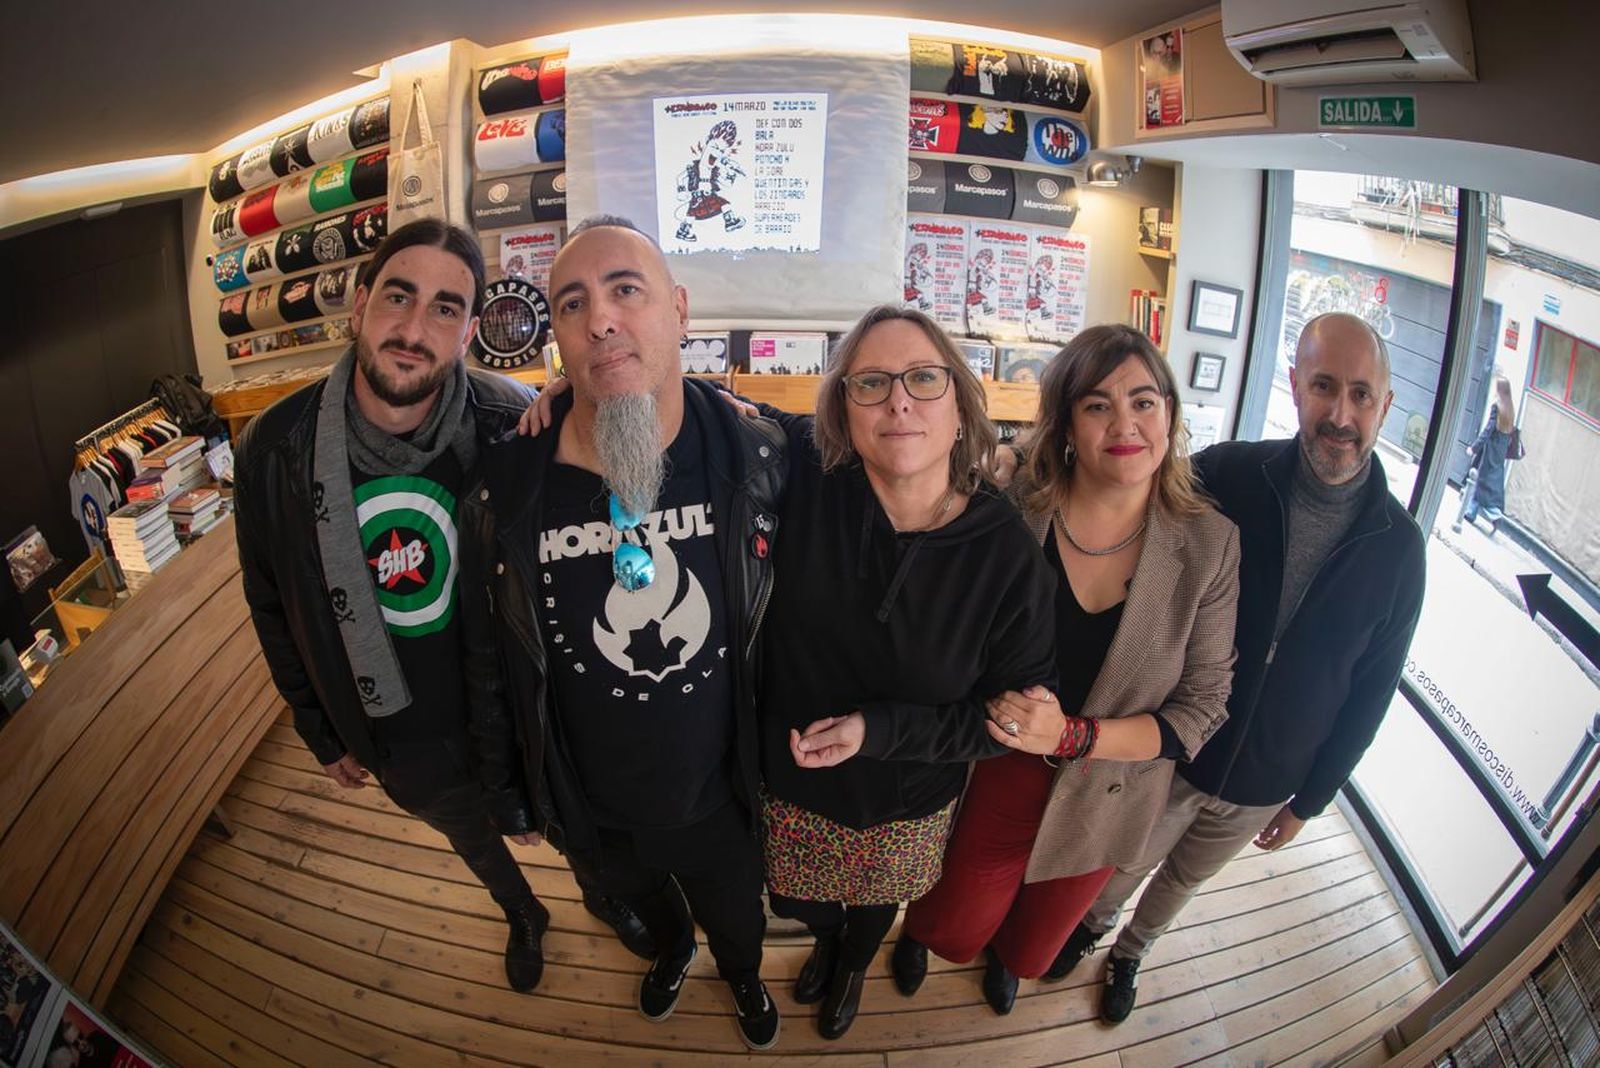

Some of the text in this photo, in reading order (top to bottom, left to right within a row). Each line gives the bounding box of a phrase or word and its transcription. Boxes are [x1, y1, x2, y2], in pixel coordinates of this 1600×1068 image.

[1324, 101, 1382, 122] SALIDA
[908, 185, 936, 195] pasos
[955, 183, 1007, 197] Marcapasos
[475, 204, 522, 217] Marcapasos
[1023, 199, 1073, 213] Marcapasos
[485, 282, 549, 322] CAPASOS
[483, 347, 538, 368] DISCOS
[641, 502, 714, 546] ZUL
[378, 539, 426, 583] SHB
[612, 687, 650, 701] DE
